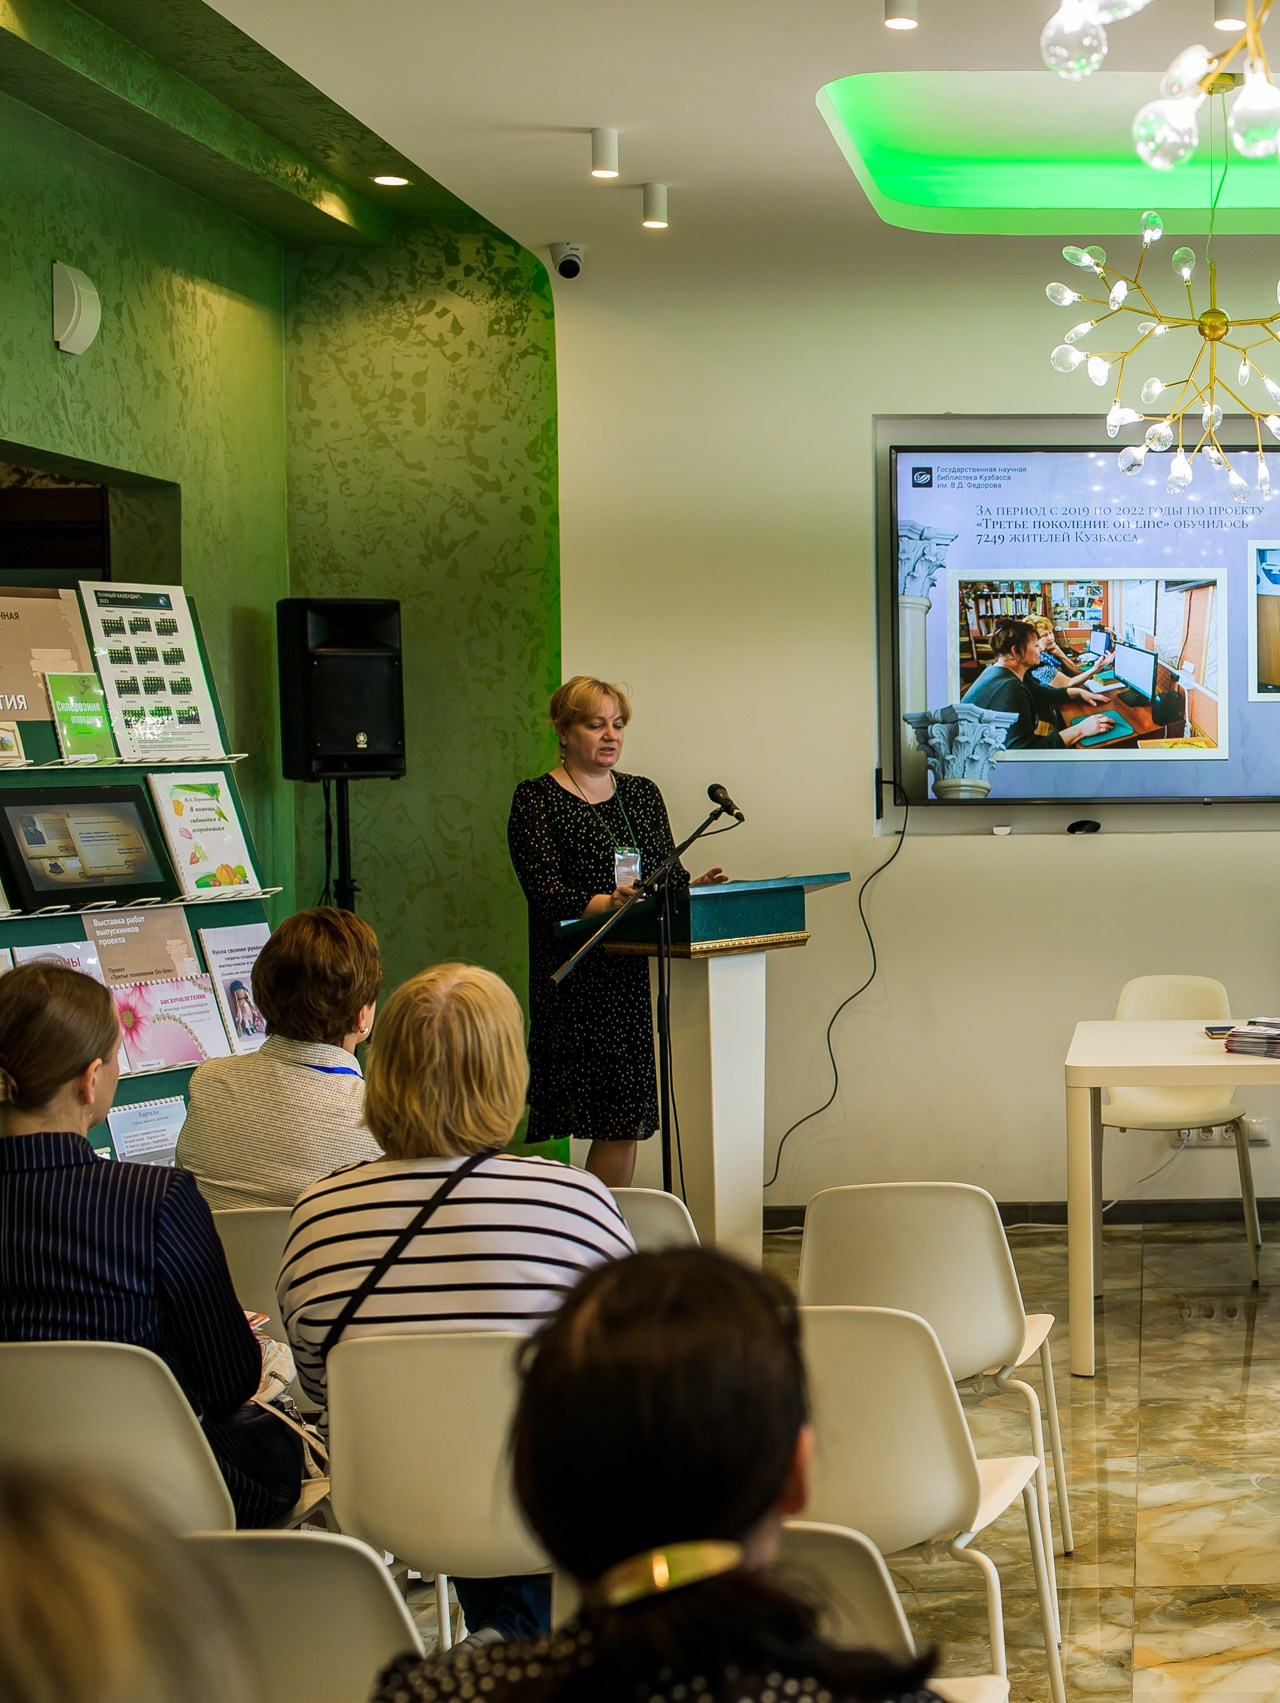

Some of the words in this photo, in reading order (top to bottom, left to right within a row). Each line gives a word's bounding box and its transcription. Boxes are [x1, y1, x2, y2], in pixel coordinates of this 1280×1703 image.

[937, 466, 997, 475] Государственная
[998, 467, 1027, 475] научная
[937, 474, 978, 482] библиотека
[979, 474, 1012, 482] Кузбасса
[966, 482, 1002, 490] Федорова
[1061, 506, 1090, 518] 2019
[1115, 506, 1145, 516] 2022
[1208, 506, 1265, 516] ПРОЕКТУ
[1032, 519, 1109, 530] ПОКОЛЕНИЕ
[1173, 519, 1249, 530] ОБУЧИЛОСЬ
[976, 533, 1005, 545] 7249
[93, 917, 125, 927] Выставка
[126, 916, 145, 926] работ
[96, 926, 140, 937] выпускников
[98, 937, 126, 947] проекта
